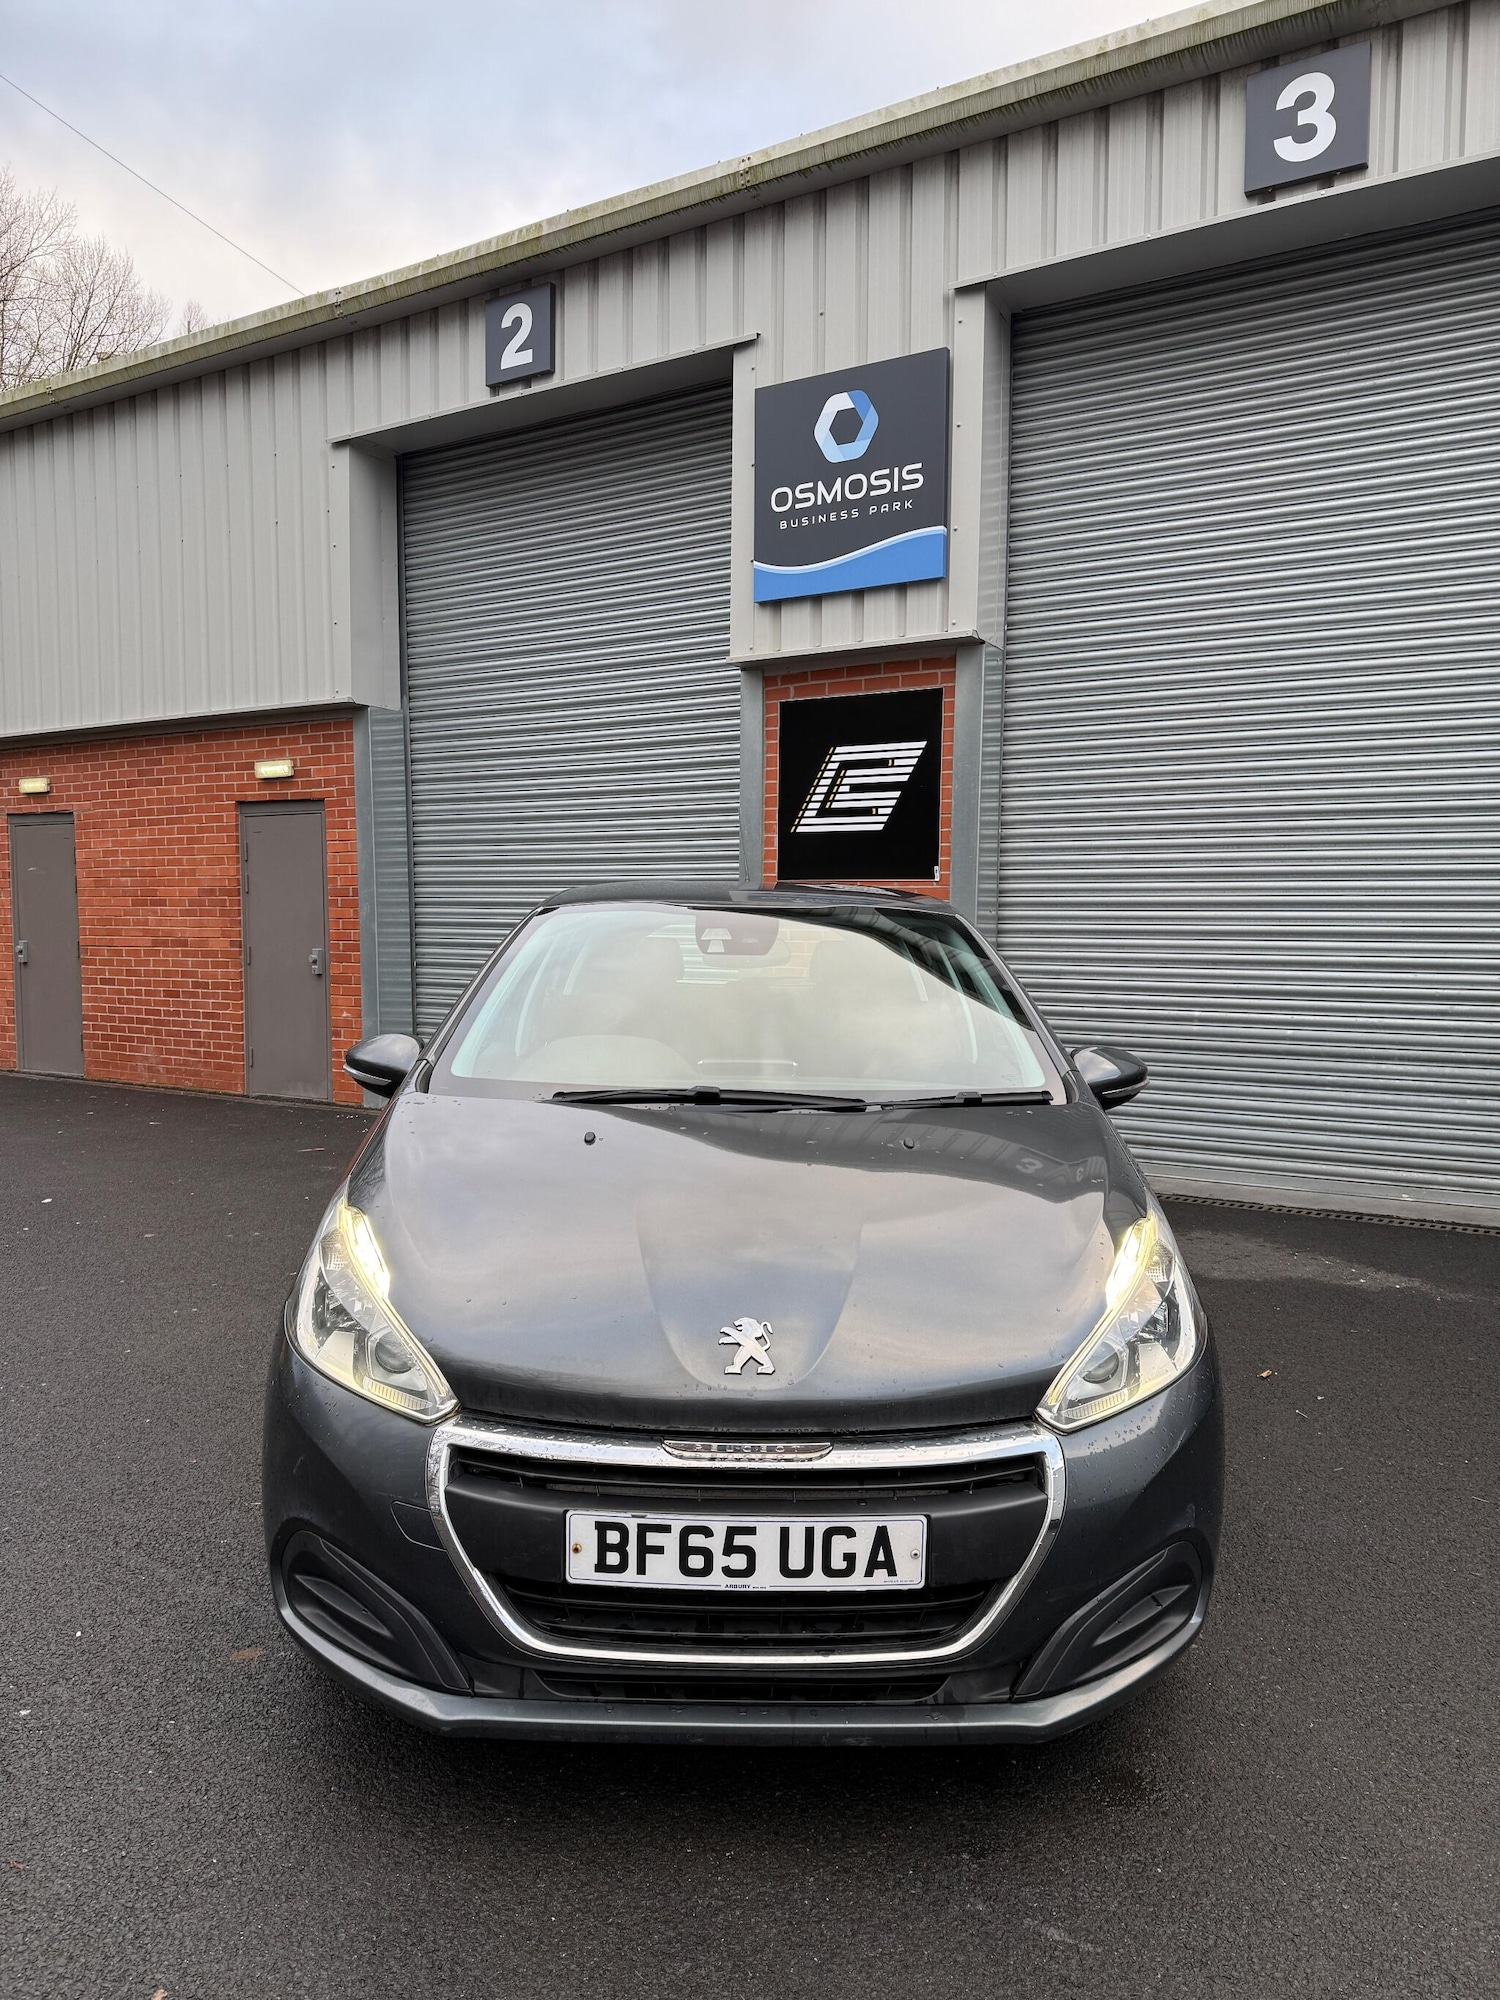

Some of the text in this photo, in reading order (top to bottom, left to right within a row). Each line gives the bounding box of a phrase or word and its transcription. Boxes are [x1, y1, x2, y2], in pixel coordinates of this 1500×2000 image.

[1273, 72, 1337, 163] 3
[500, 302, 533, 370] 2
[770, 462, 924, 513] OSMOSIS
[779, 499, 913, 530] BUSINESS PARK
[594, 1520, 897, 1579] BF65 UGA
